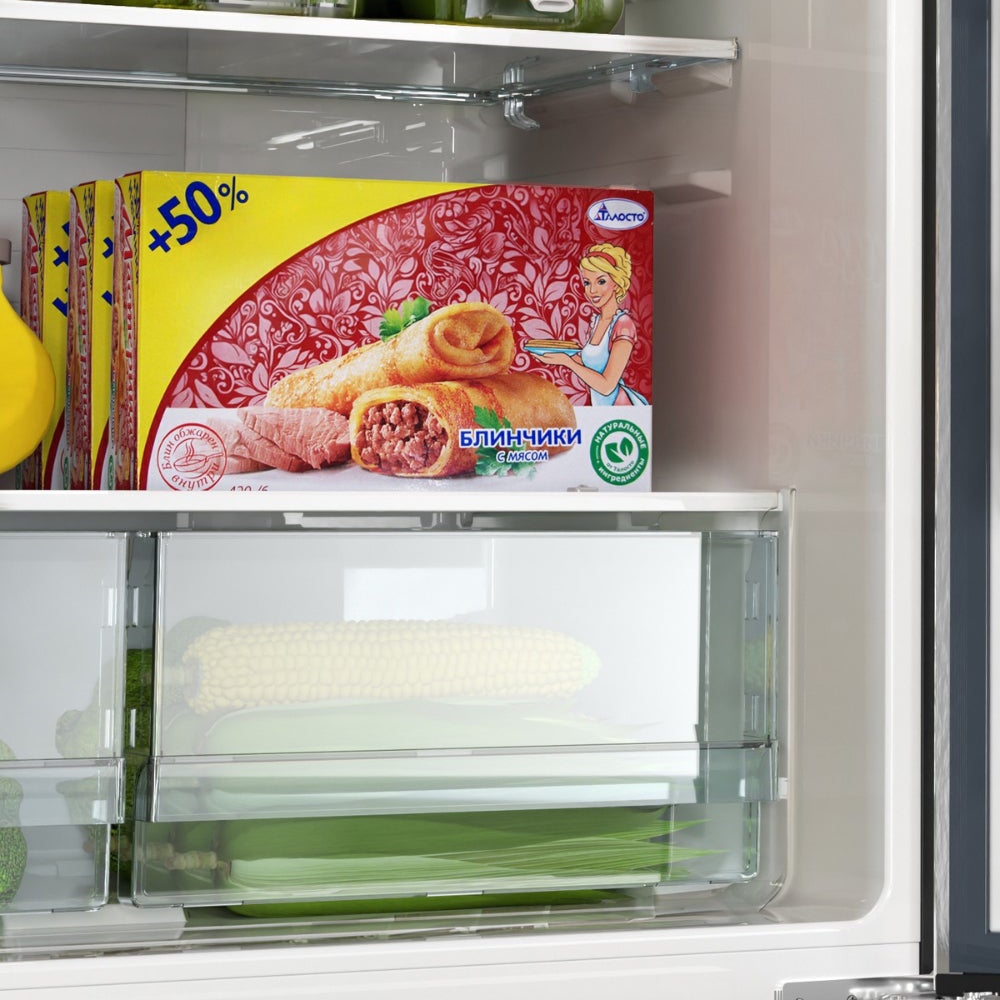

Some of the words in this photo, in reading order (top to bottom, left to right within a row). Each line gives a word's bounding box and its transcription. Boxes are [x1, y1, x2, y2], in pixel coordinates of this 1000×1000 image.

[148, 176, 249, 253] +50%
[162, 440, 175, 470] Блин
[173, 427, 219, 450] обжарен
[459, 428, 583, 448] БЛИНЧИКИ
[594, 422, 647, 449] НАТУРАЛЬНЫЕ
[171, 462, 220, 491] внутри
[598, 457, 645, 482] ингредиенты
